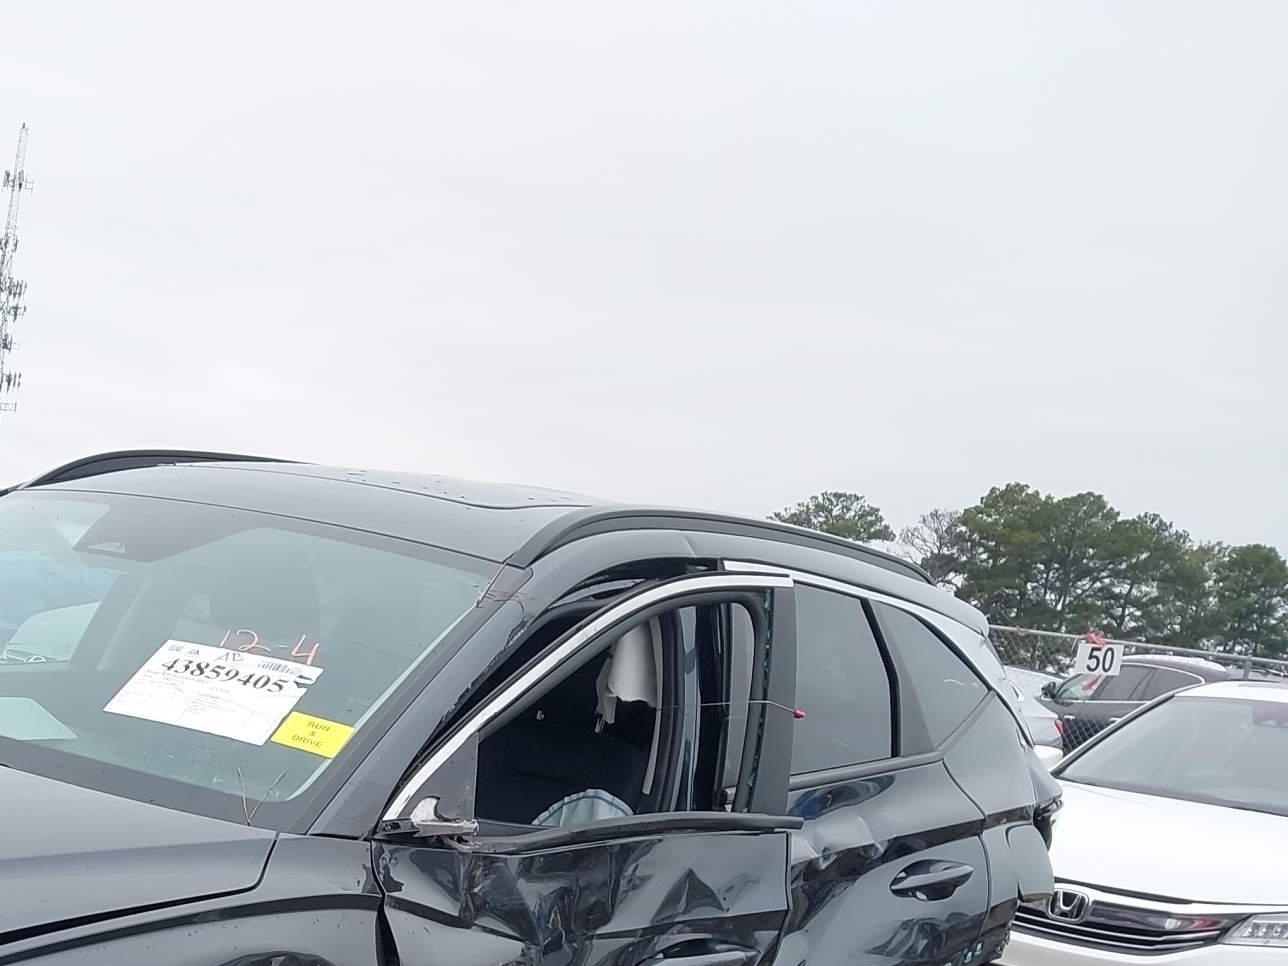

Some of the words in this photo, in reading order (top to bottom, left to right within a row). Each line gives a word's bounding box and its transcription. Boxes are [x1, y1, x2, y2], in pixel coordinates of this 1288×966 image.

[218, 628, 320, 665] 12-4
[1085, 647, 1115, 673] 50
[161, 658, 289, 693] 43859405
[307, 720, 331, 732] RUN
[291, 734, 325, 748] DRIVE
